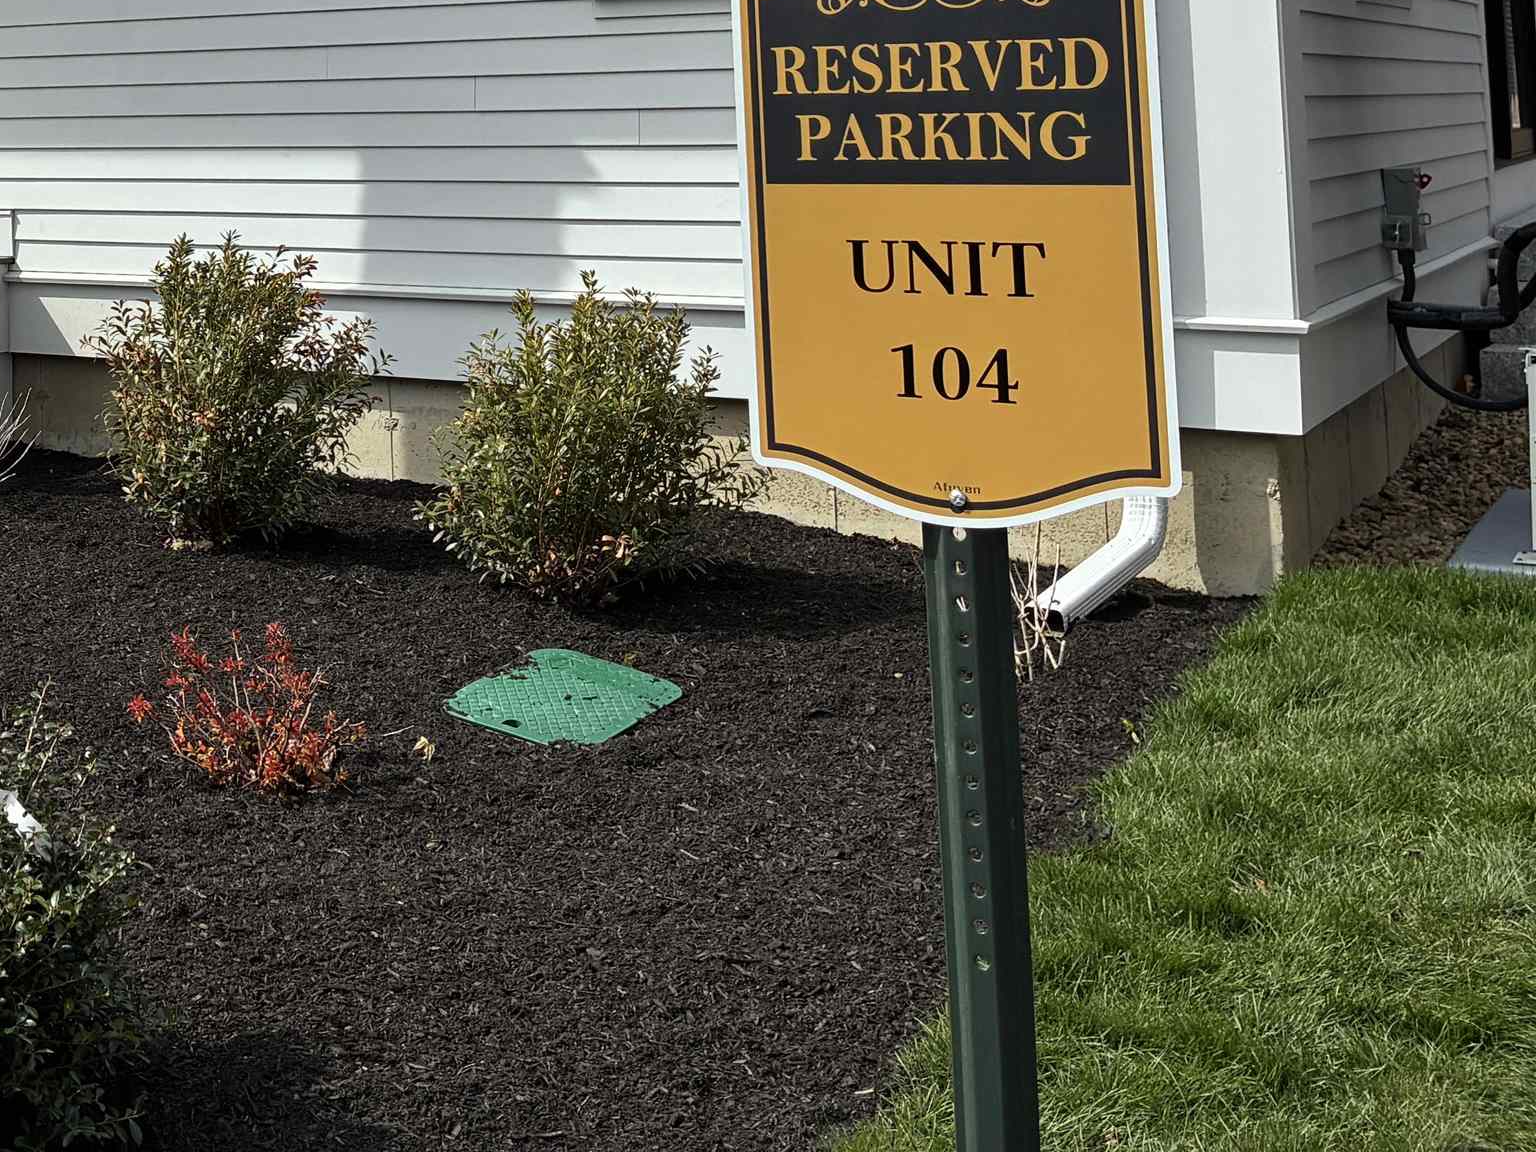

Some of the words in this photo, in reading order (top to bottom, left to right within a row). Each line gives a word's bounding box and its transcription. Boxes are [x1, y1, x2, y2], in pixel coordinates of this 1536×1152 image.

[771, 37, 1109, 95] RESERVED
[795, 110, 1092, 161] PARKING
[845, 239, 1046, 298] UNIT
[890, 343, 1019, 405] 104
